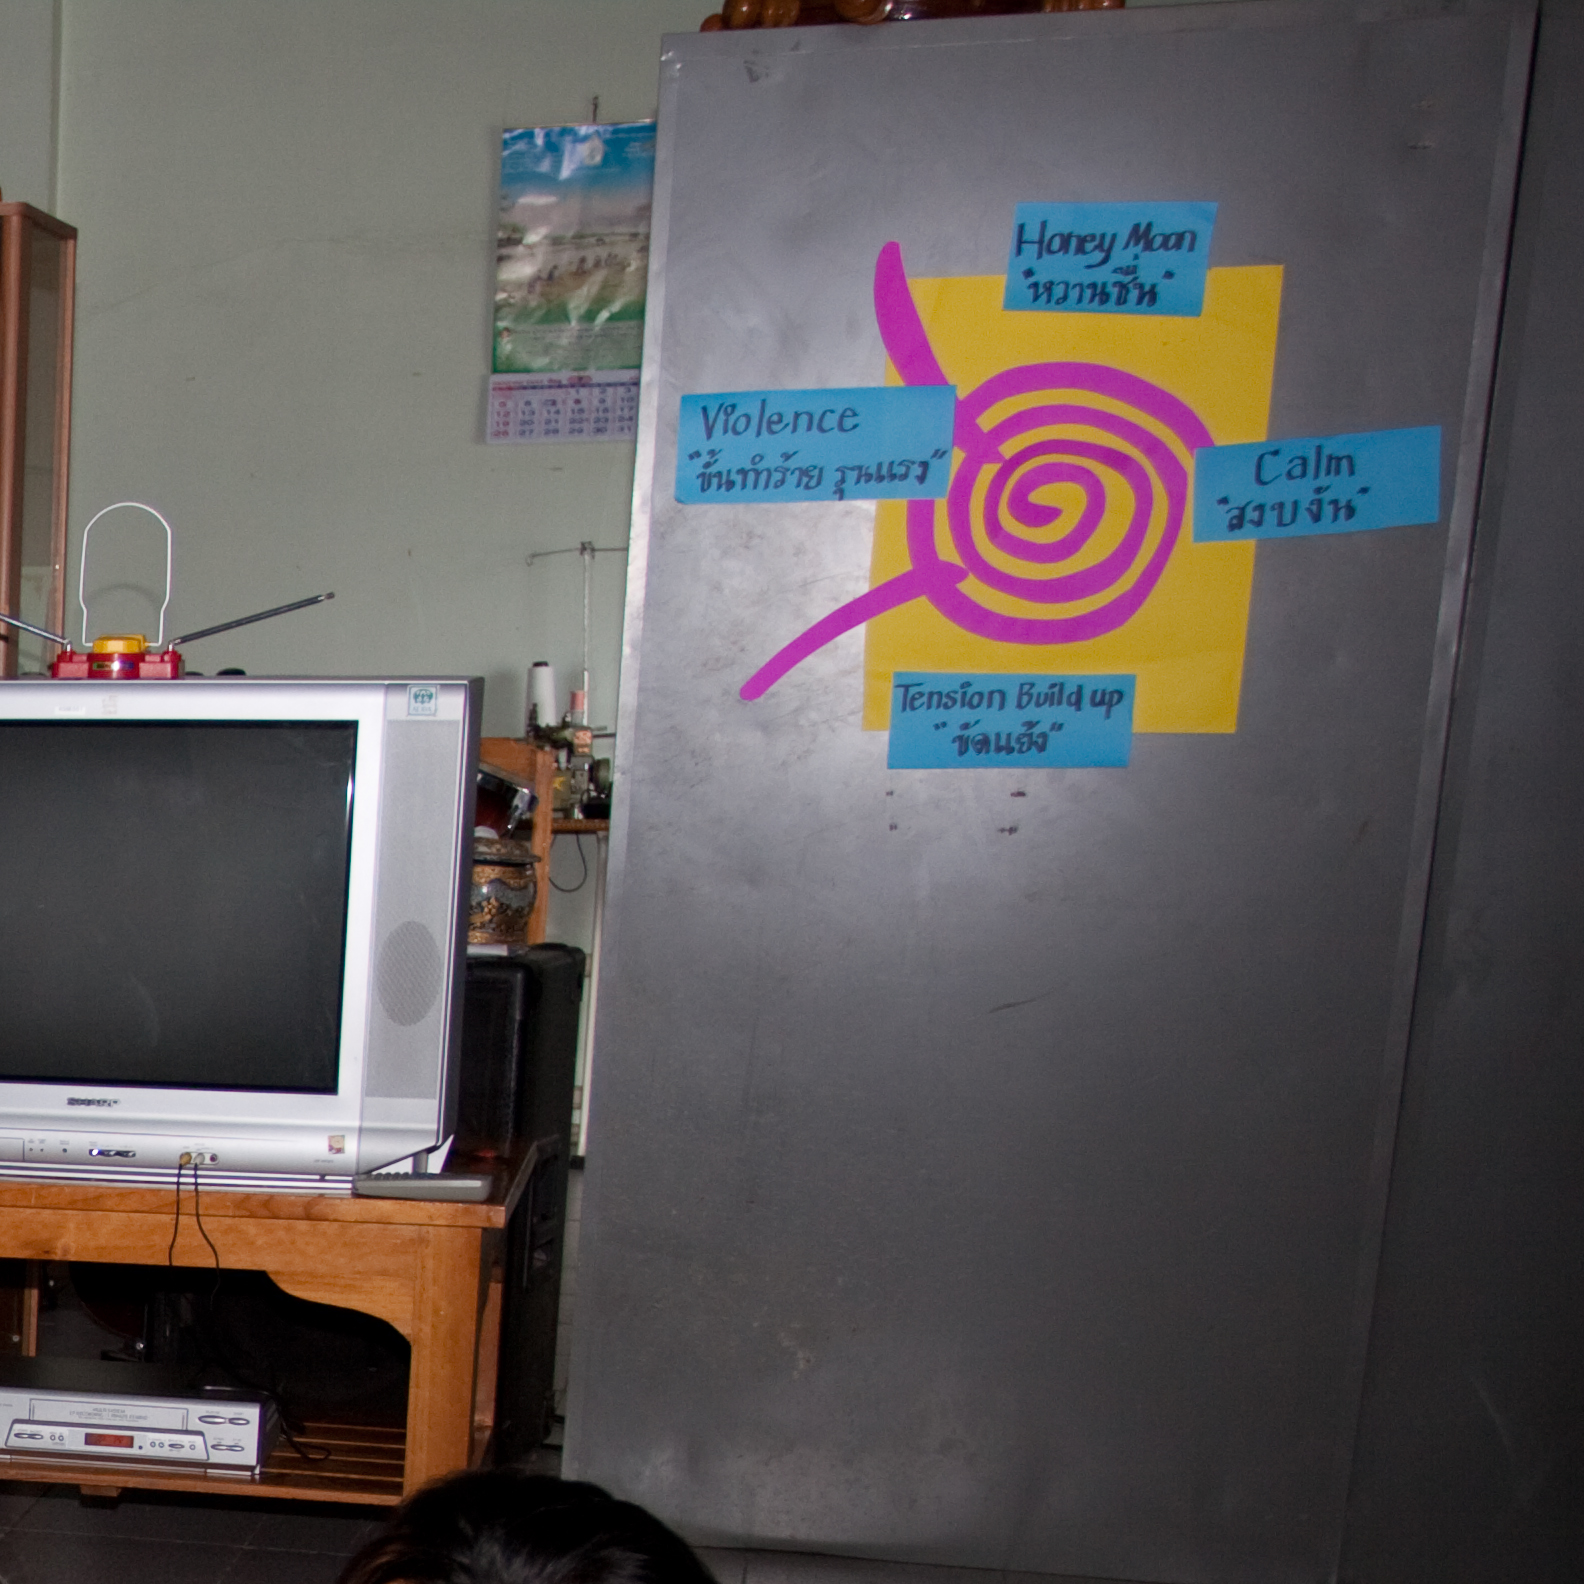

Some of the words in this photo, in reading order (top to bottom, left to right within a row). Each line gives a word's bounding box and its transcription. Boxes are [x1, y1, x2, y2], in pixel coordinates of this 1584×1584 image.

[1014, 219, 1118, 270] Honey
[1122, 220, 1197, 253] Moon
[700, 397, 860, 442] Violence
[1254, 444, 1356, 487] Calm
[894, 680, 1007, 713] Tension
[1015, 681, 1084, 712] Build
[1089, 687, 1125, 720] up
